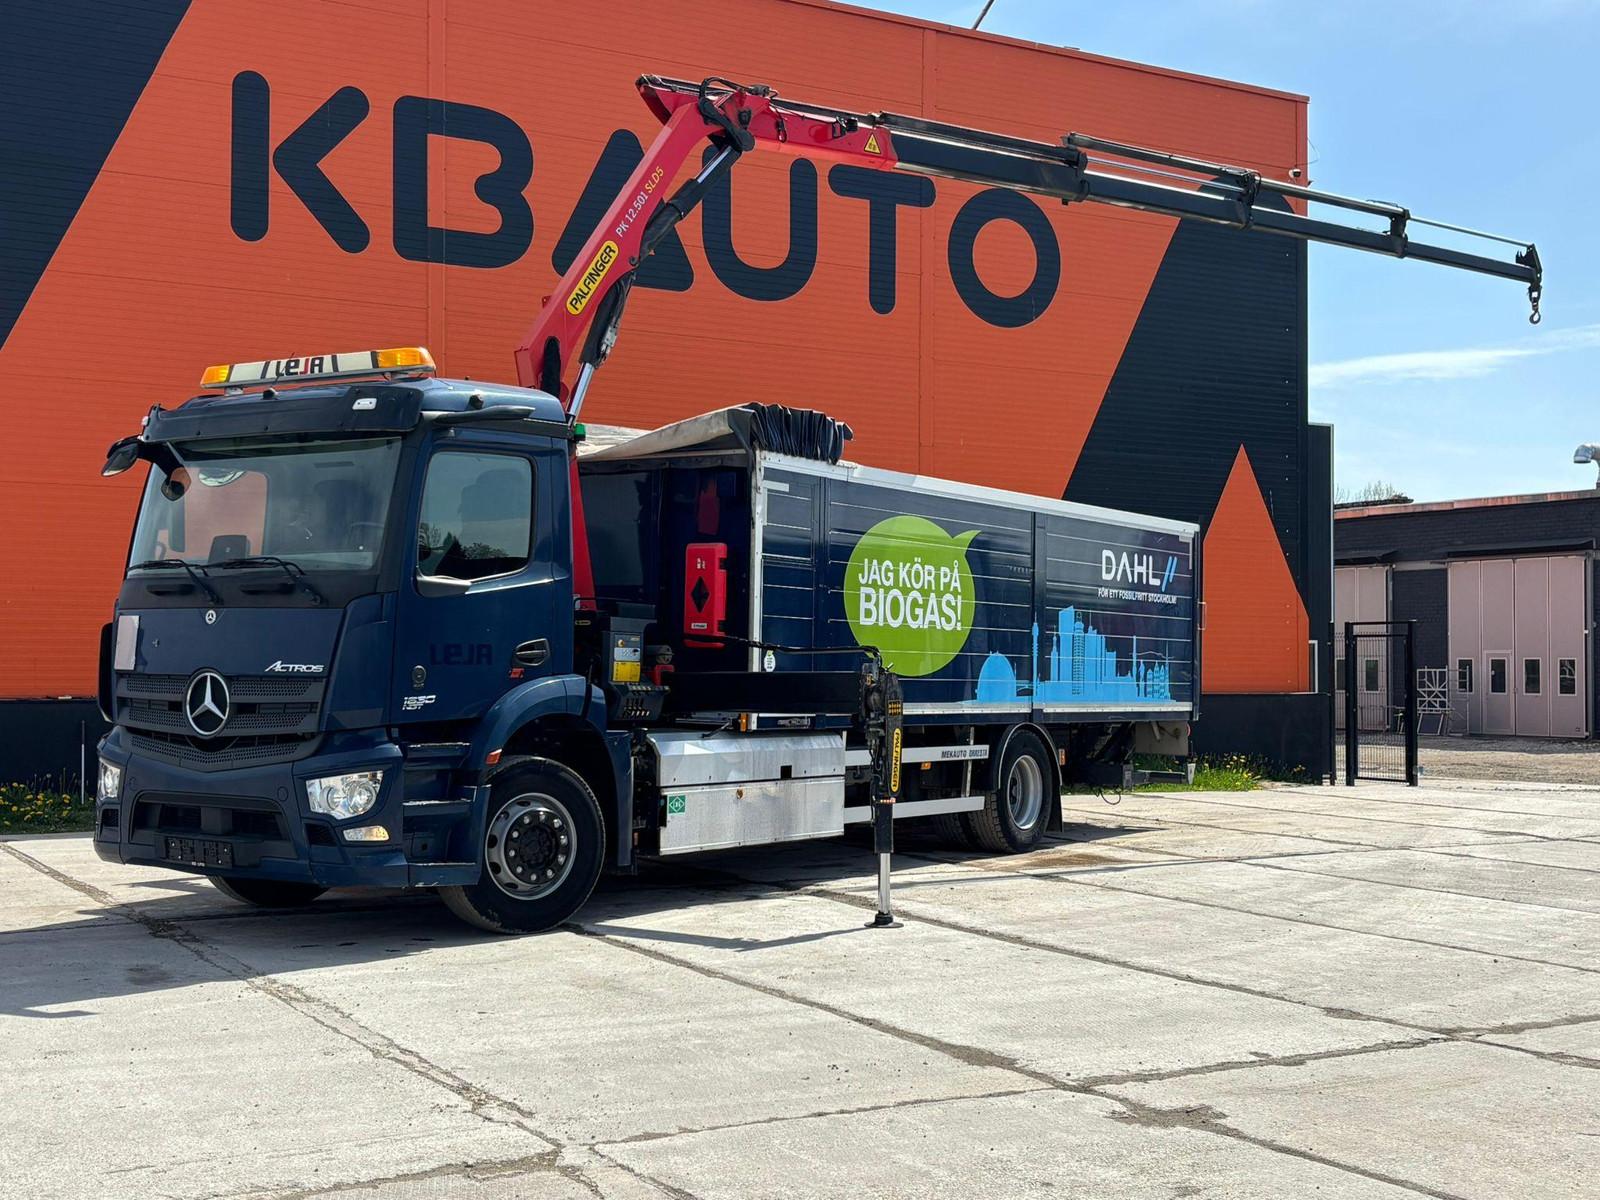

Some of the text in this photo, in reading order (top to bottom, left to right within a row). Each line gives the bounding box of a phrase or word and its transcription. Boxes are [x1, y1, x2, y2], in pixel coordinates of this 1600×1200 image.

[230, 70, 1061, 328] KBAUTO
[615, 166, 665, 238] PK 12.501 SLD5
[569, 244, 617, 312] PALFINGER
[858, 557, 962, 593] JAG KÖR PÅ
[1101, 549, 1161, 586] DAHL
[859, 586, 962, 632] BIOGAS!
[1109, 589, 1119, 599] ETT
[890, 731, 901, 789] PALFINGER
